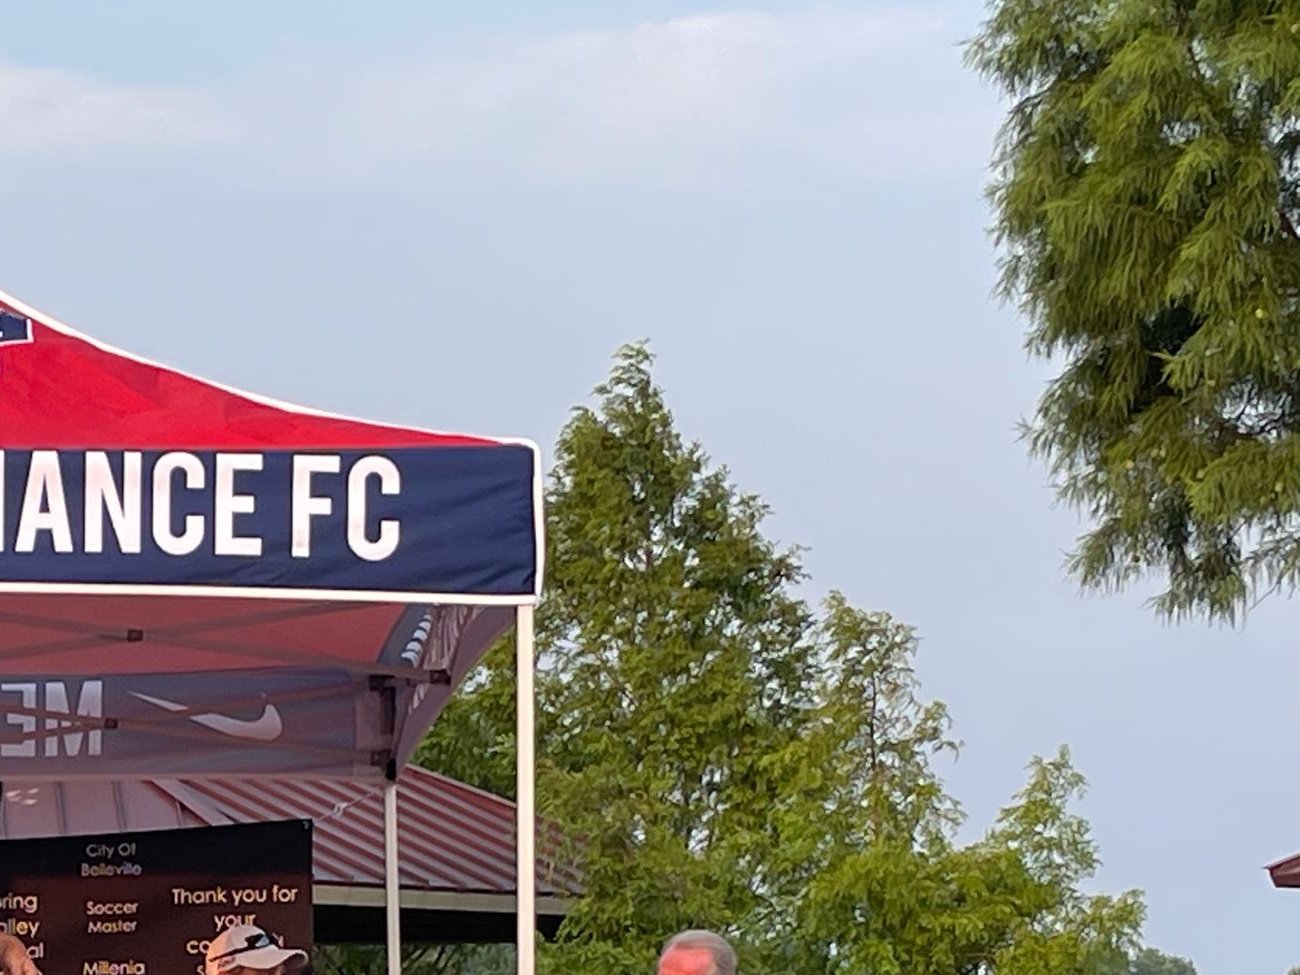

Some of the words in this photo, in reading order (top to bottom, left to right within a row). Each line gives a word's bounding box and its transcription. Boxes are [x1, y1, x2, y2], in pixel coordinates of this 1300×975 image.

[291, 454, 401, 562] FC
[86, 843, 115, 859] City
[81, 861, 142, 877] Belleville
[172, 886, 228, 905] Thank
[232, 888, 267, 906] you
[272, 884, 299, 903] for
[86, 901, 139, 915] Soccer
[87, 920, 137, 933] Master
